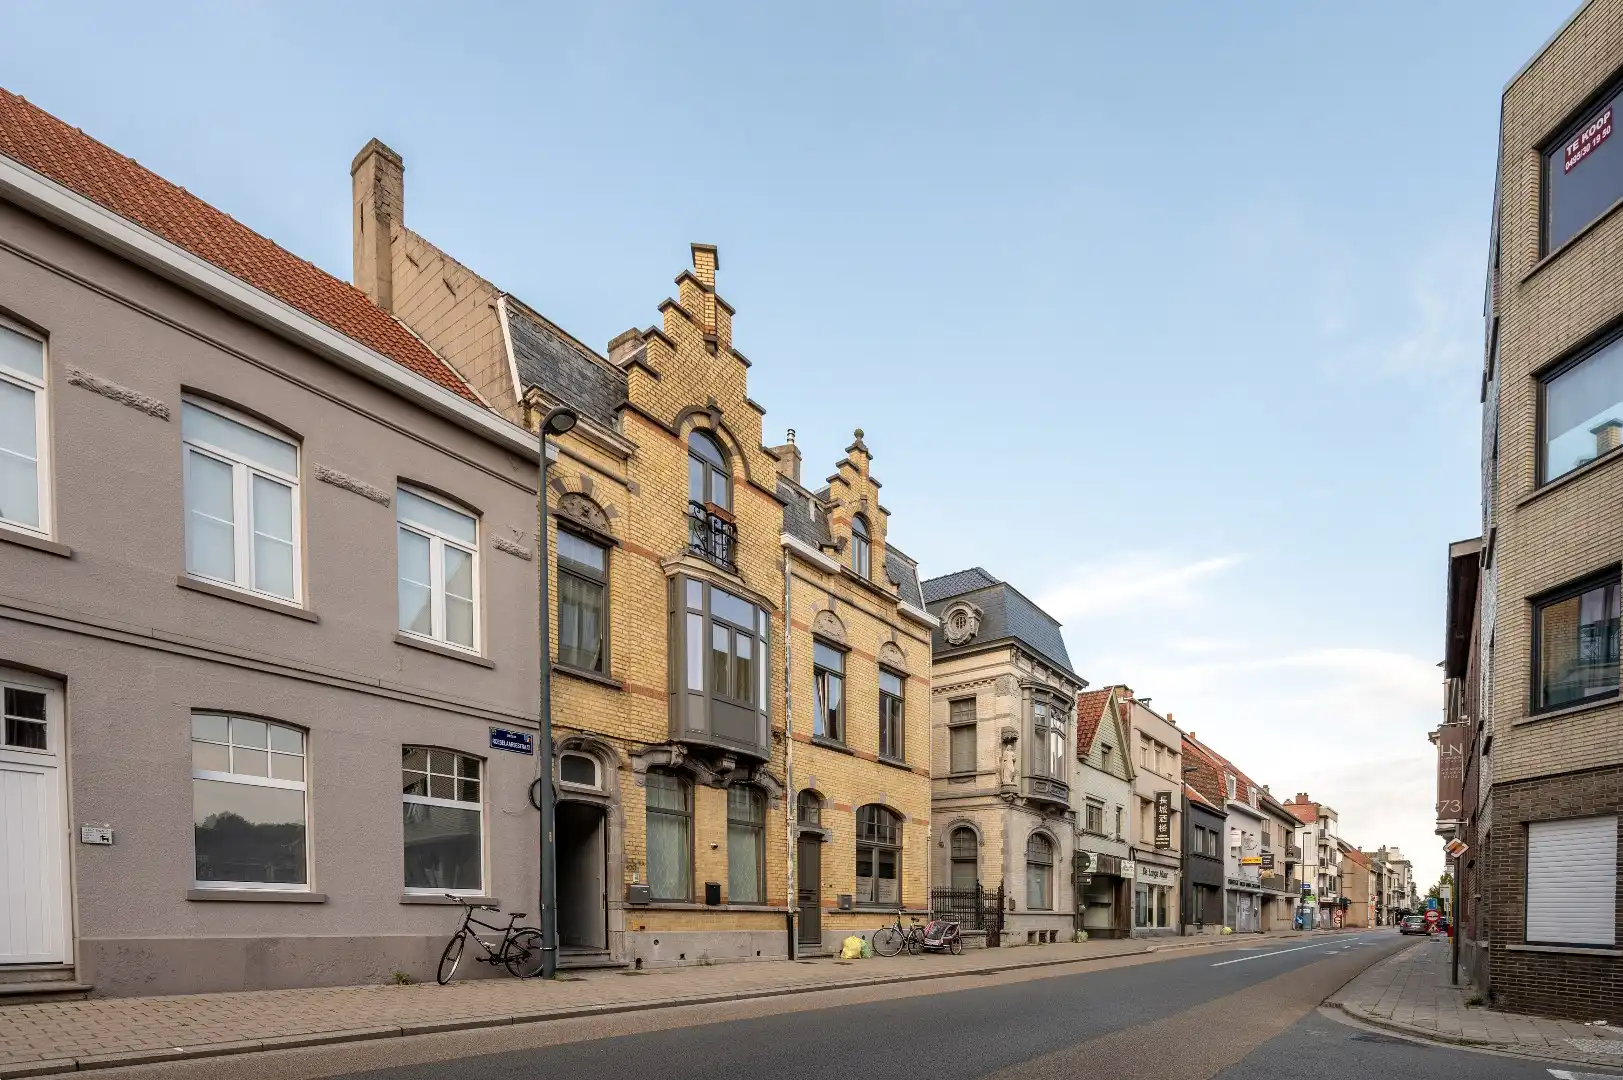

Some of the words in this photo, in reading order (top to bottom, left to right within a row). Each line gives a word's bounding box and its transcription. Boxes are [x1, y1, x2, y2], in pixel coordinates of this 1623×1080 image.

[1565, 142, 1590, 170] 0495/30
[1592, 133, 1601, 146] 19
[1566, 138, 1579, 156] TE
[1581, 111, 1610, 143] KOOP
[1440, 799, 1461, 813] 73
